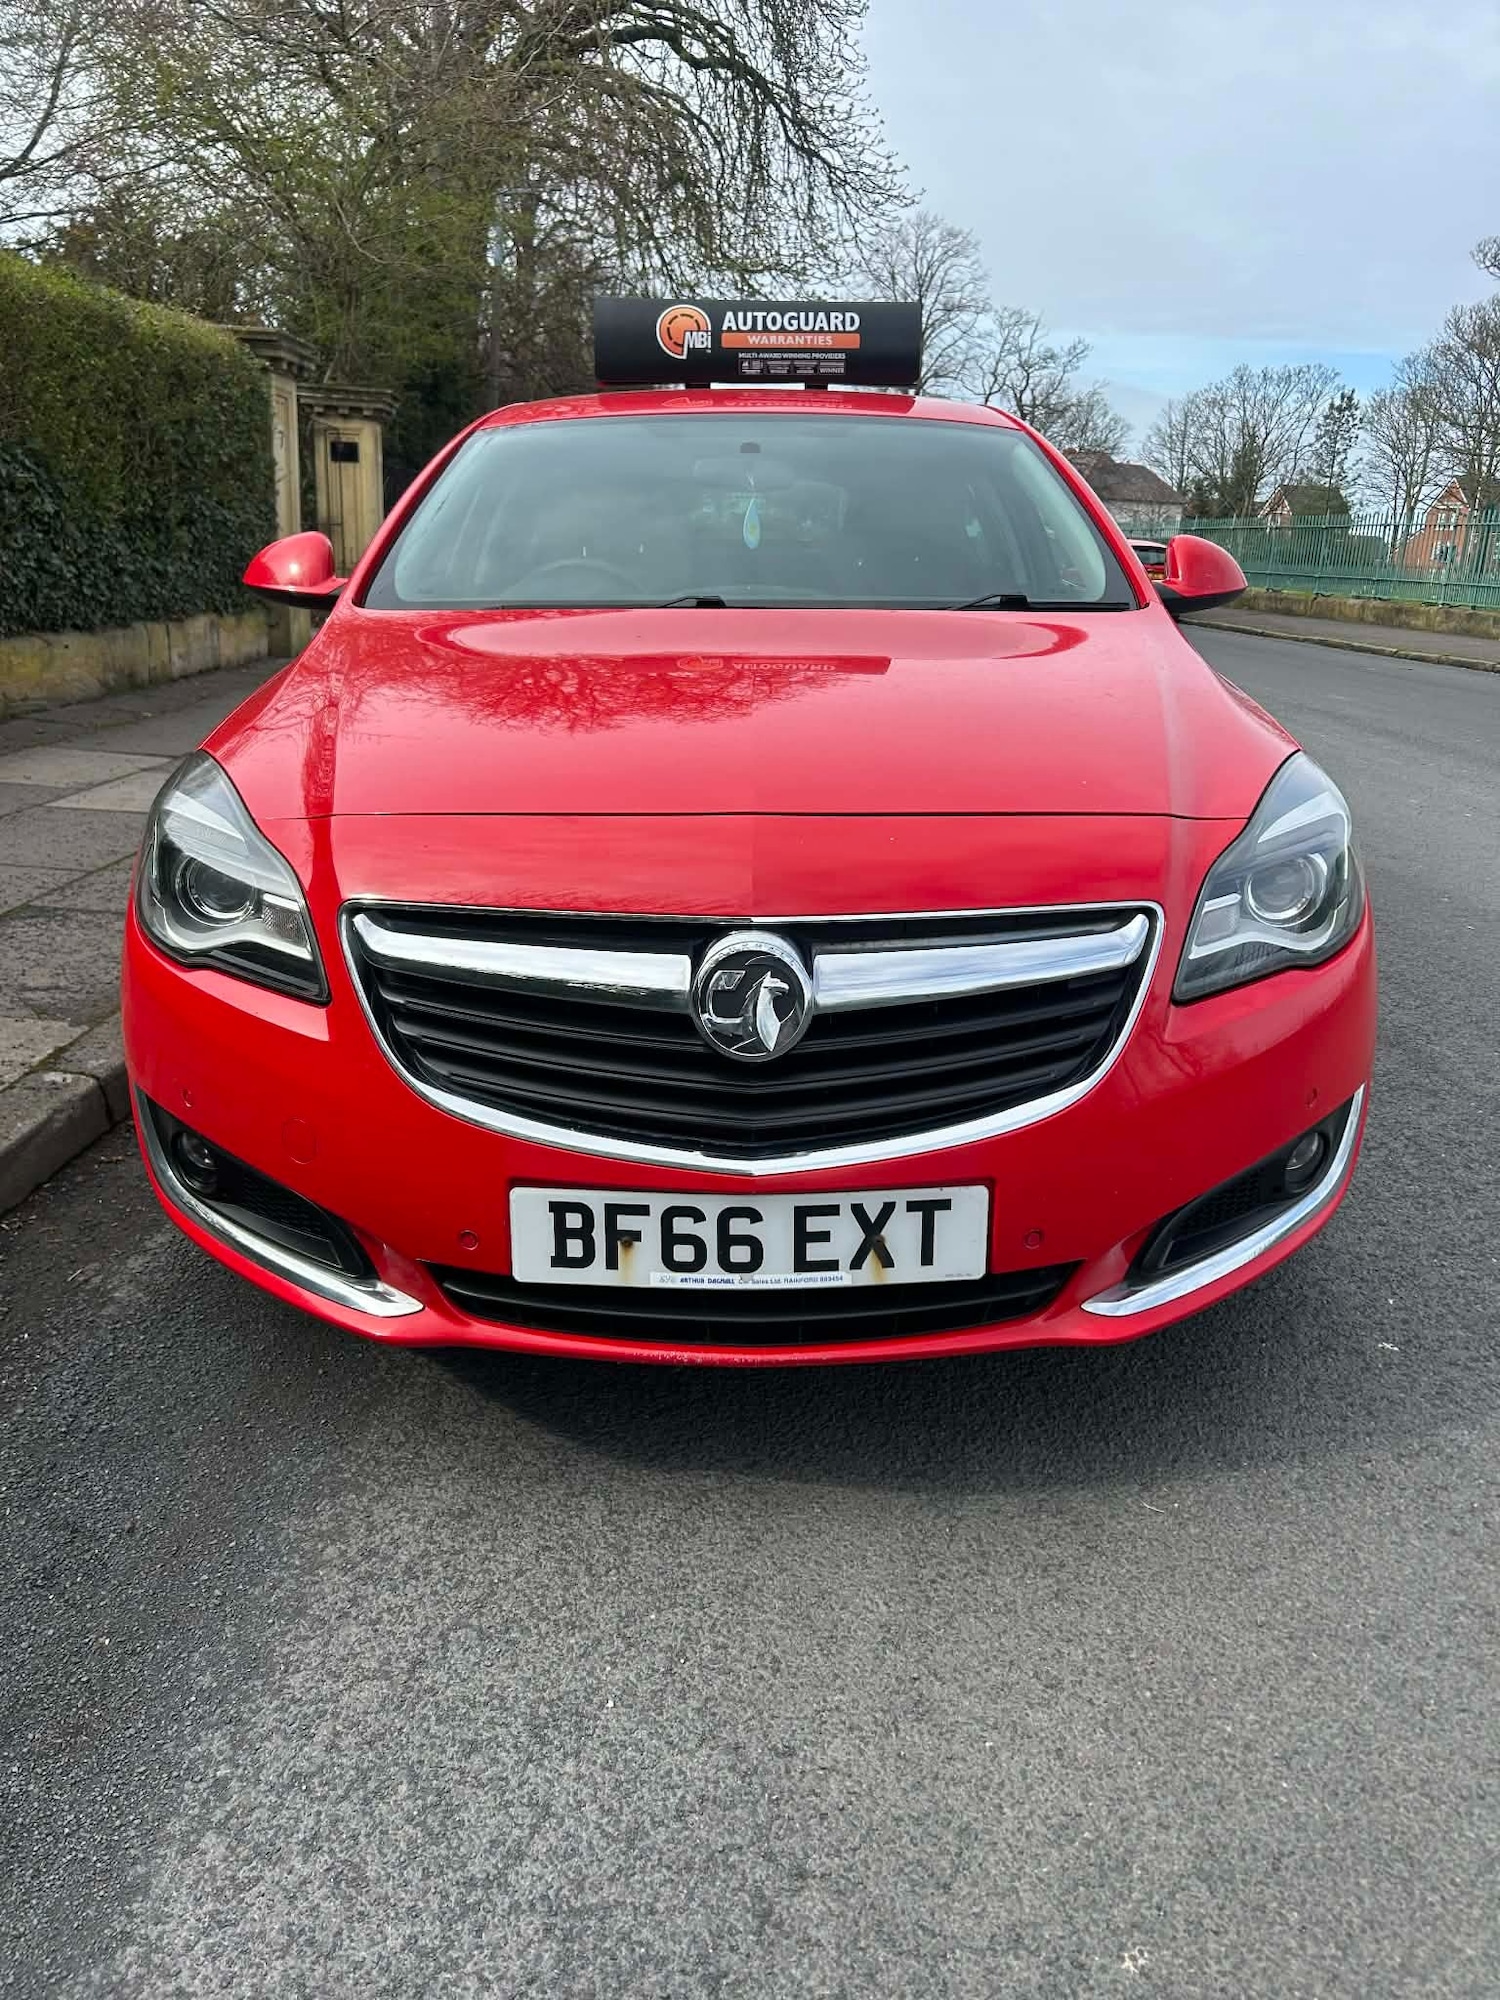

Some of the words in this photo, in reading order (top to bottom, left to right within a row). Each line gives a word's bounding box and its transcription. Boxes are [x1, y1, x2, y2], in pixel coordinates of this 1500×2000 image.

[721, 311, 860, 331] AUTOGUARD
[747, 334, 833, 345] WARRANTIES
[811, 352, 846, 360] PROVIDERS
[548, 1199, 764, 1274] BF66
[793, 1198, 952, 1273] EXT
